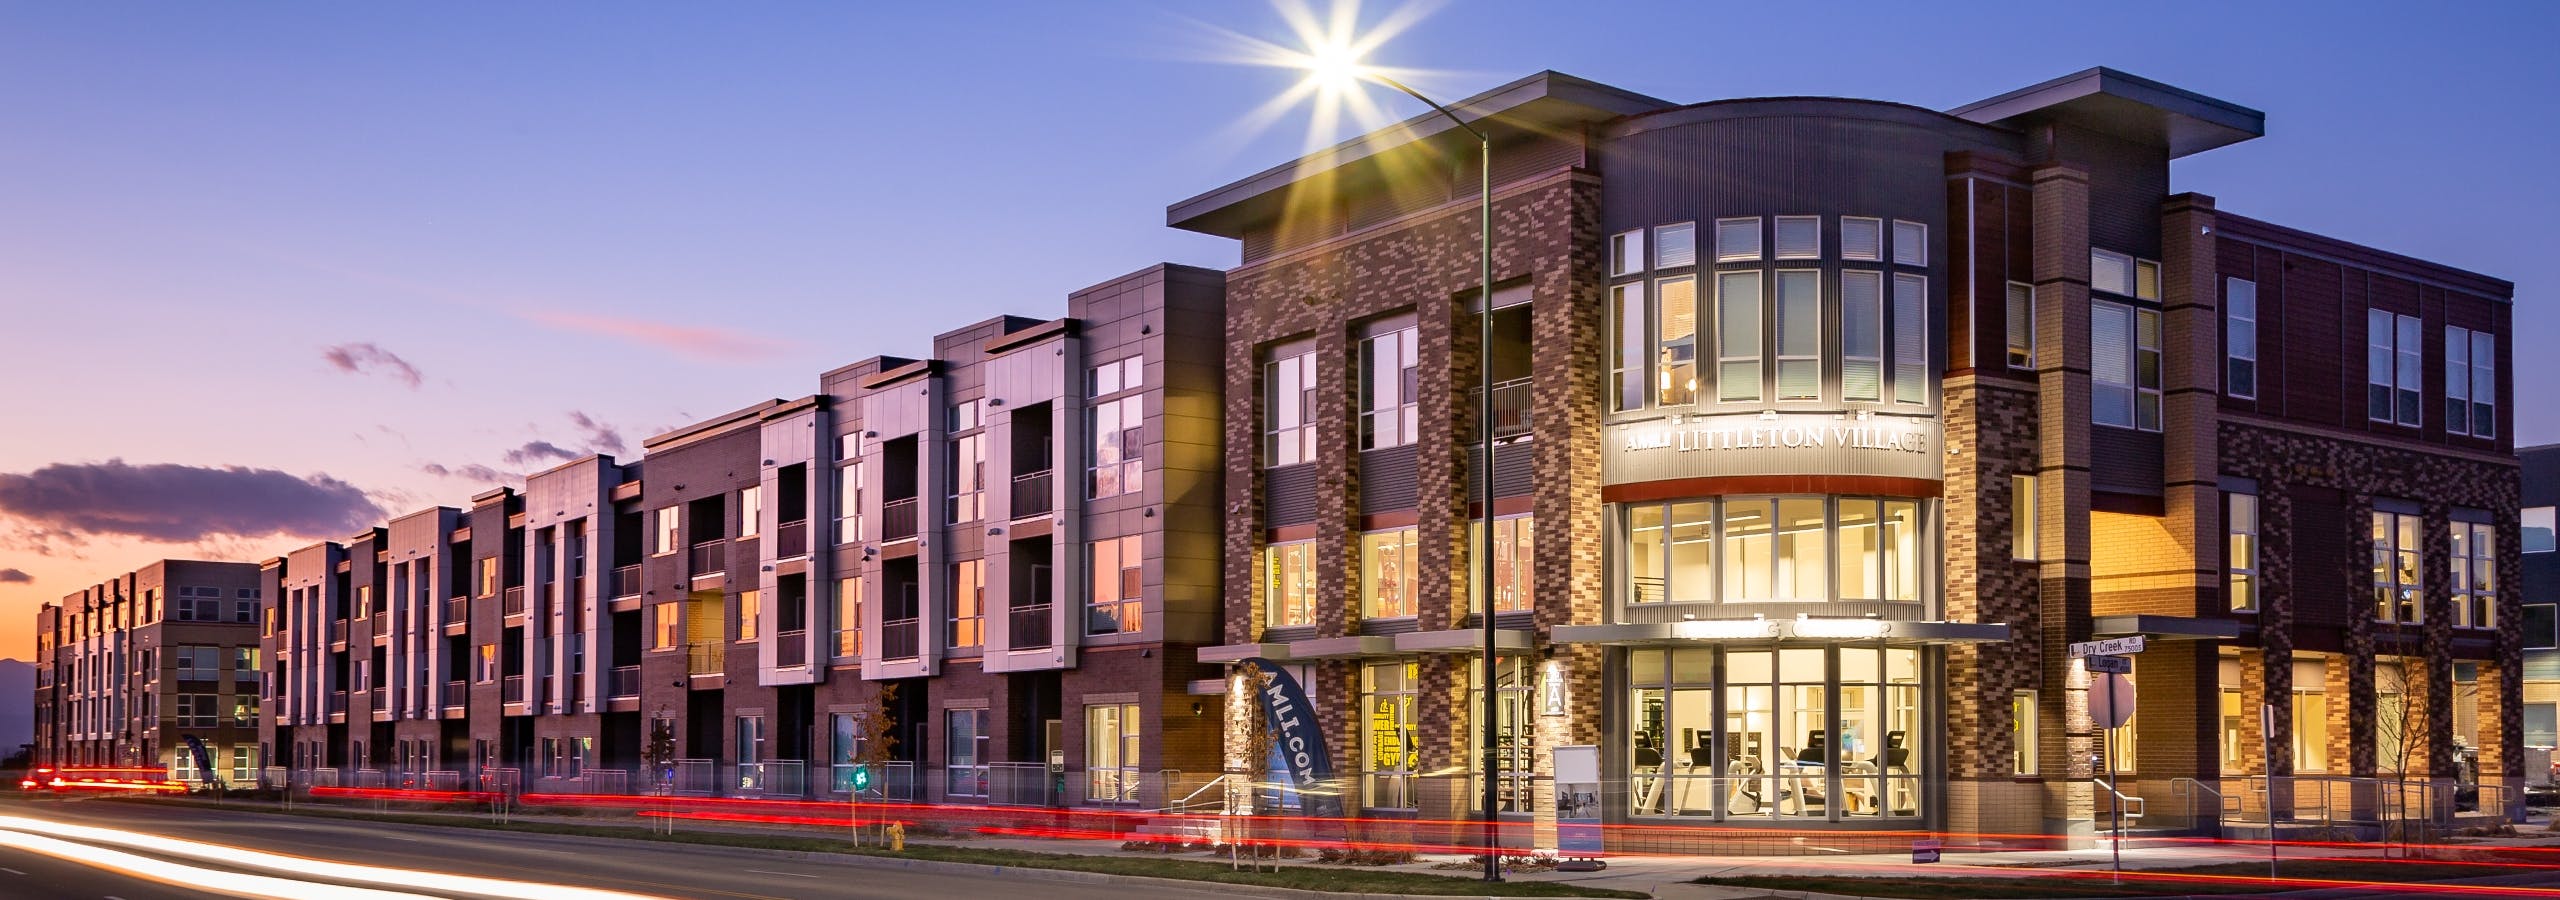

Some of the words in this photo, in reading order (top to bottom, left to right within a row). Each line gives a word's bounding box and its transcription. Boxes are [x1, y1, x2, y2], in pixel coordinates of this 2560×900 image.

[1678, 427, 1825, 452] LITTLETON
[1832, 427, 1927, 454] VILLAGE
[2083, 644, 2096, 654] Dry
[2100, 640, 2122, 652] Creek
[1260, 671, 1316, 786] AMLI.COM
